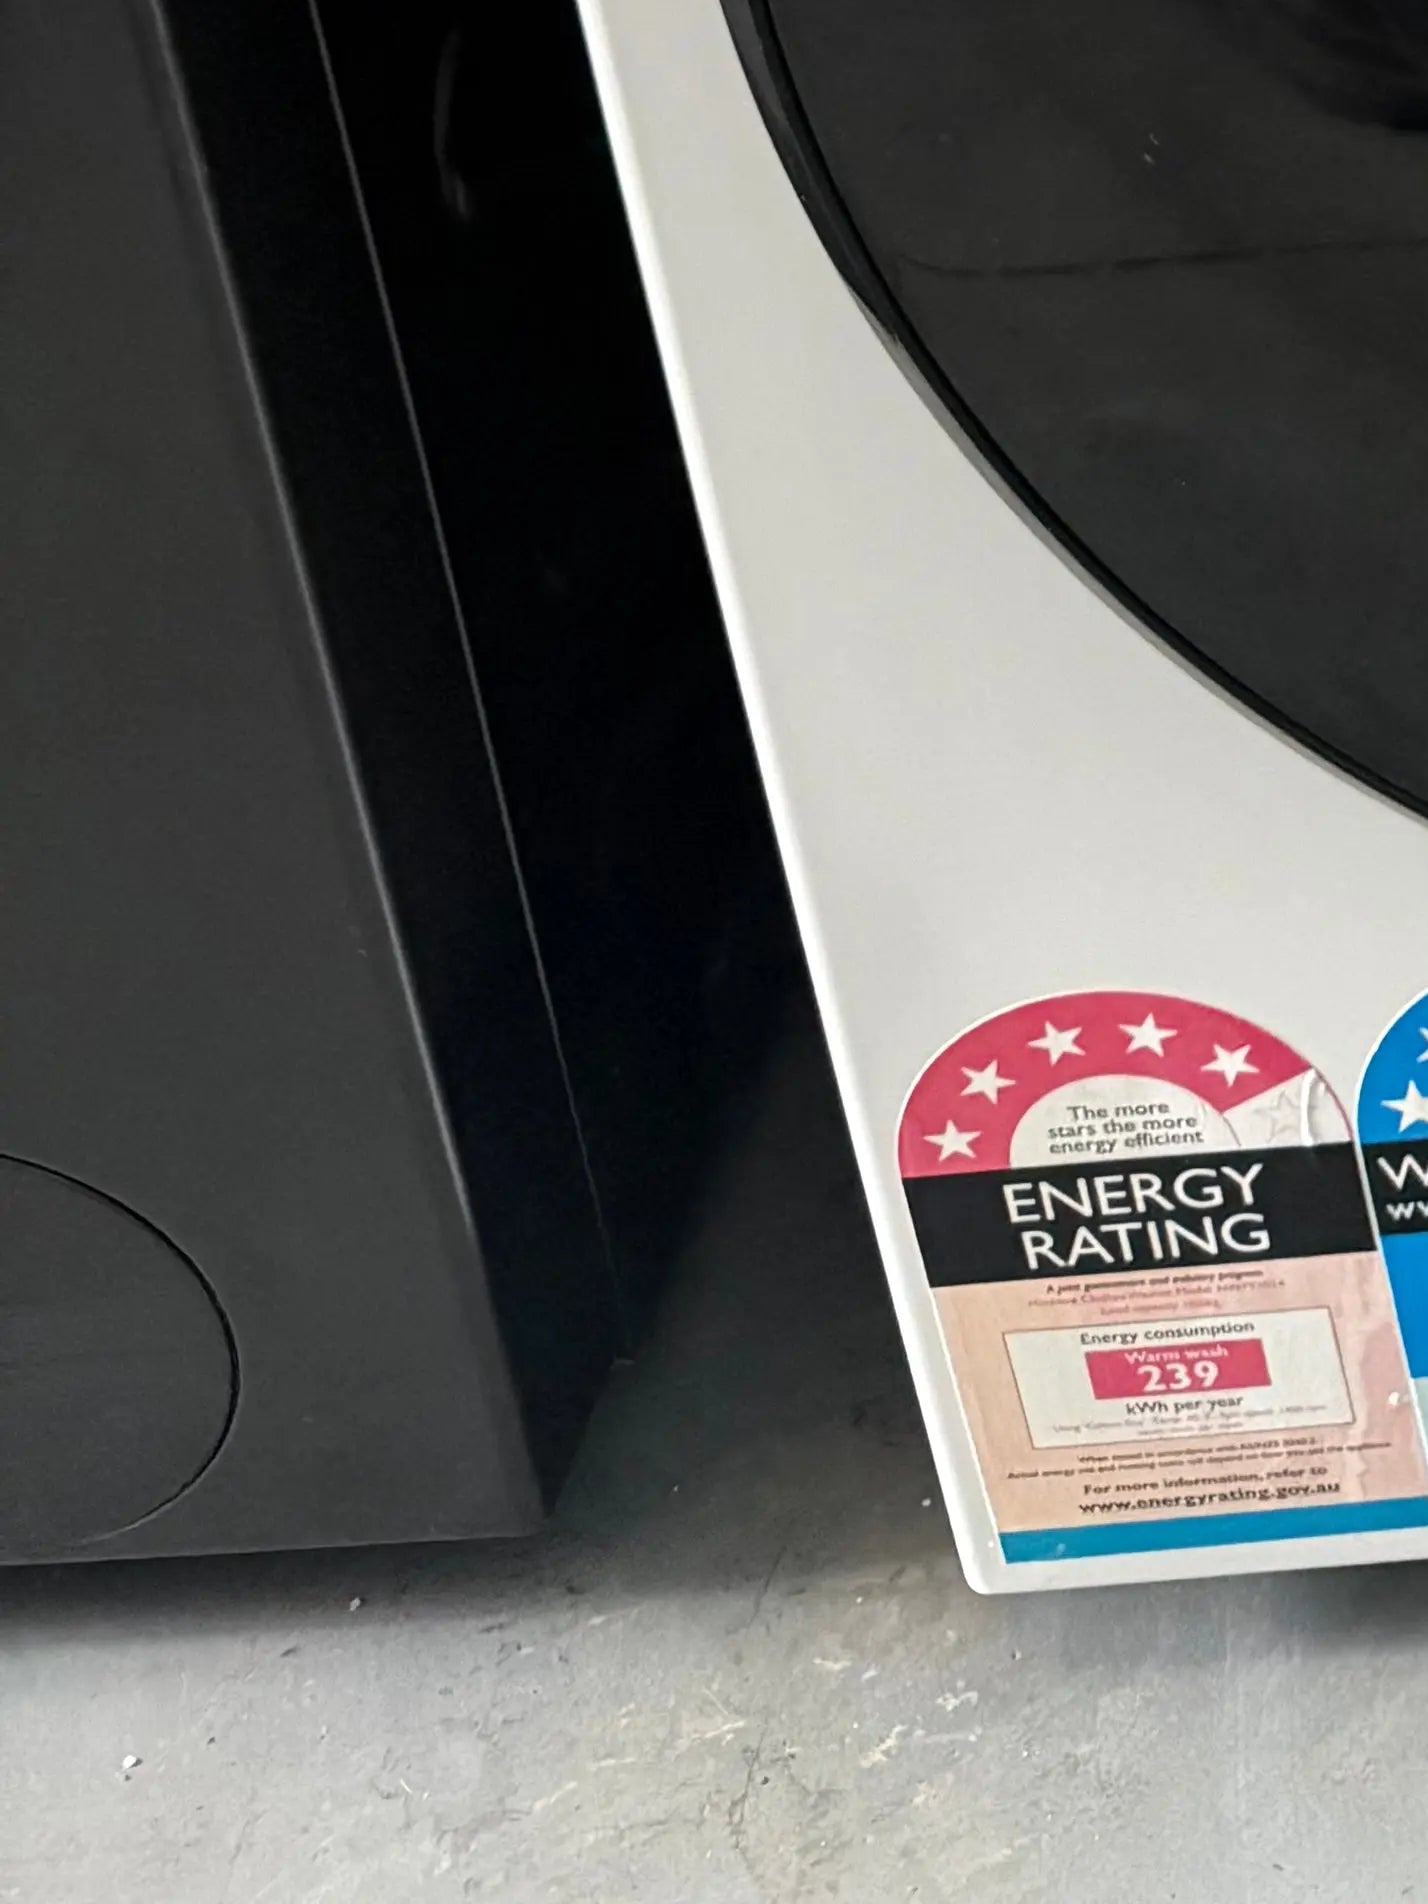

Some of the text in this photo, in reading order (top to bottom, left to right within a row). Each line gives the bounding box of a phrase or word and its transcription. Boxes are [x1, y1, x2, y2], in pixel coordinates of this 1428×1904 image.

[1067, 1101, 1170, 1122] The more
[1048, 1115, 1198, 1139] stars the more
[1049, 1130, 1204, 1155] energy efficient
[1002, 1162, 1264, 1224] ENERGY
[1021, 1212, 1271, 1270] RATING
[1080, 1321, 1255, 1346] Energy consumption
[1124, 1346, 1229, 1365] Warm wash
[1136, 1361, 1220, 1392] 239
[1126, 1395, 1244, 1416] kWh per year
[1083, 1465, 1328, 1496] For more information, refer to
